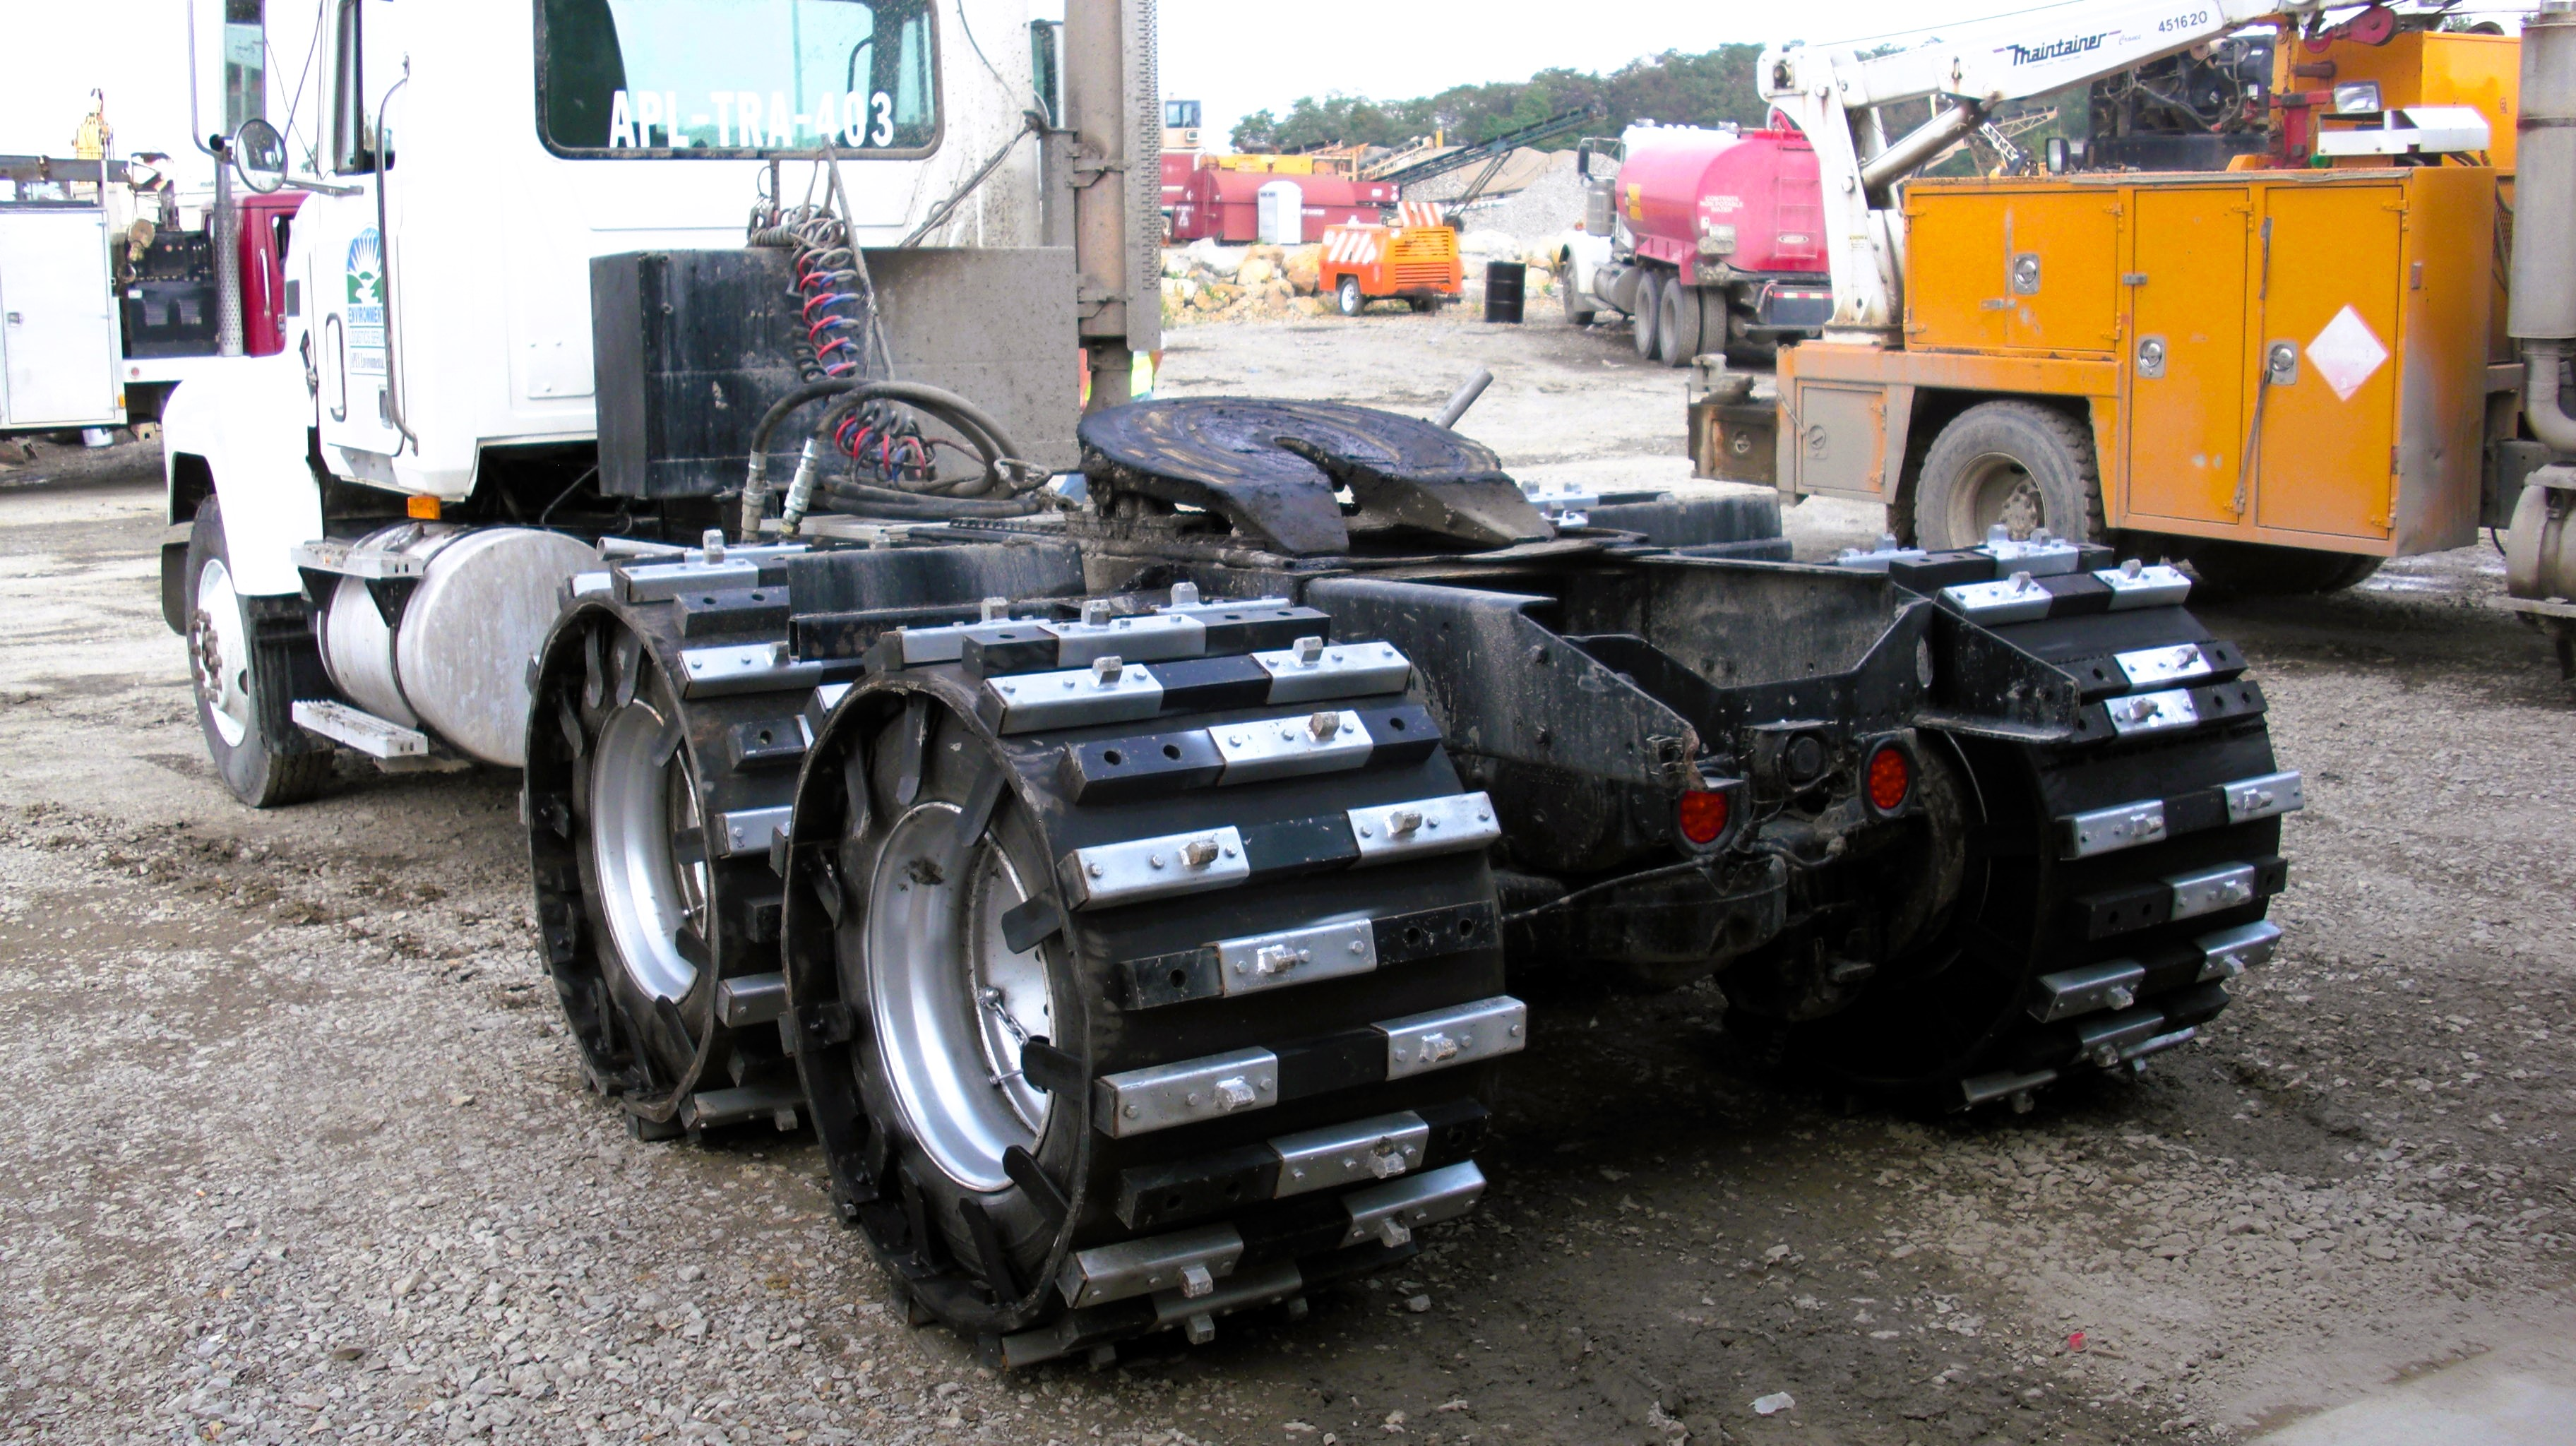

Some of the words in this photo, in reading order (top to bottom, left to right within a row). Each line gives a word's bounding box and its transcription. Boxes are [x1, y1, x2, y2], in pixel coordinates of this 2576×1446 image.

[2158, 11, 2208, 32] 451620
[2006, 33, 2107, 66] Maintainer
[609, 90, 895, 148] APL-TRA-403
